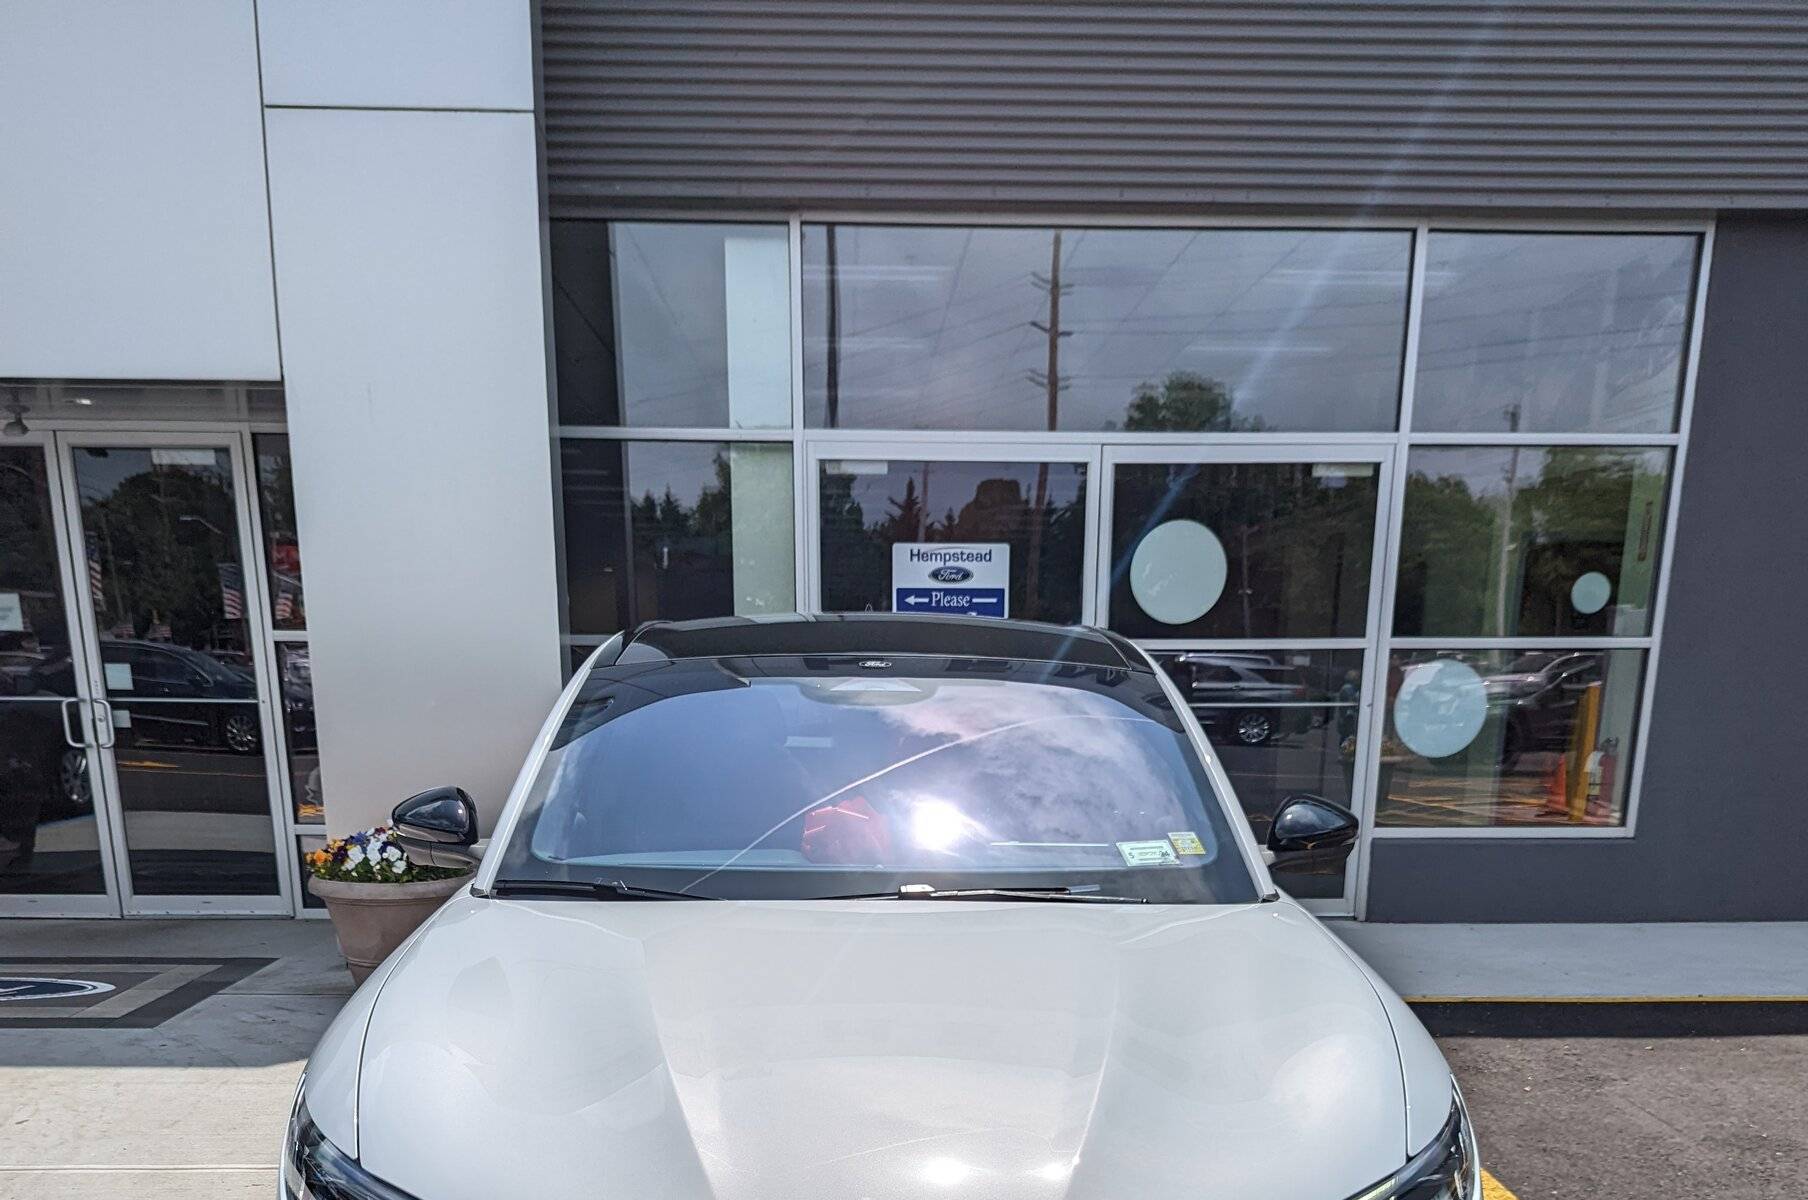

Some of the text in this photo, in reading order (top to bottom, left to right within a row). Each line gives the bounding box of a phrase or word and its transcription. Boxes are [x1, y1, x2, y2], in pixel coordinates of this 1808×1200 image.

[910, 549, 992, 565] Hempstead
[938, 568, 963, 580] Ford
[931, 591, 970, 607] Please
